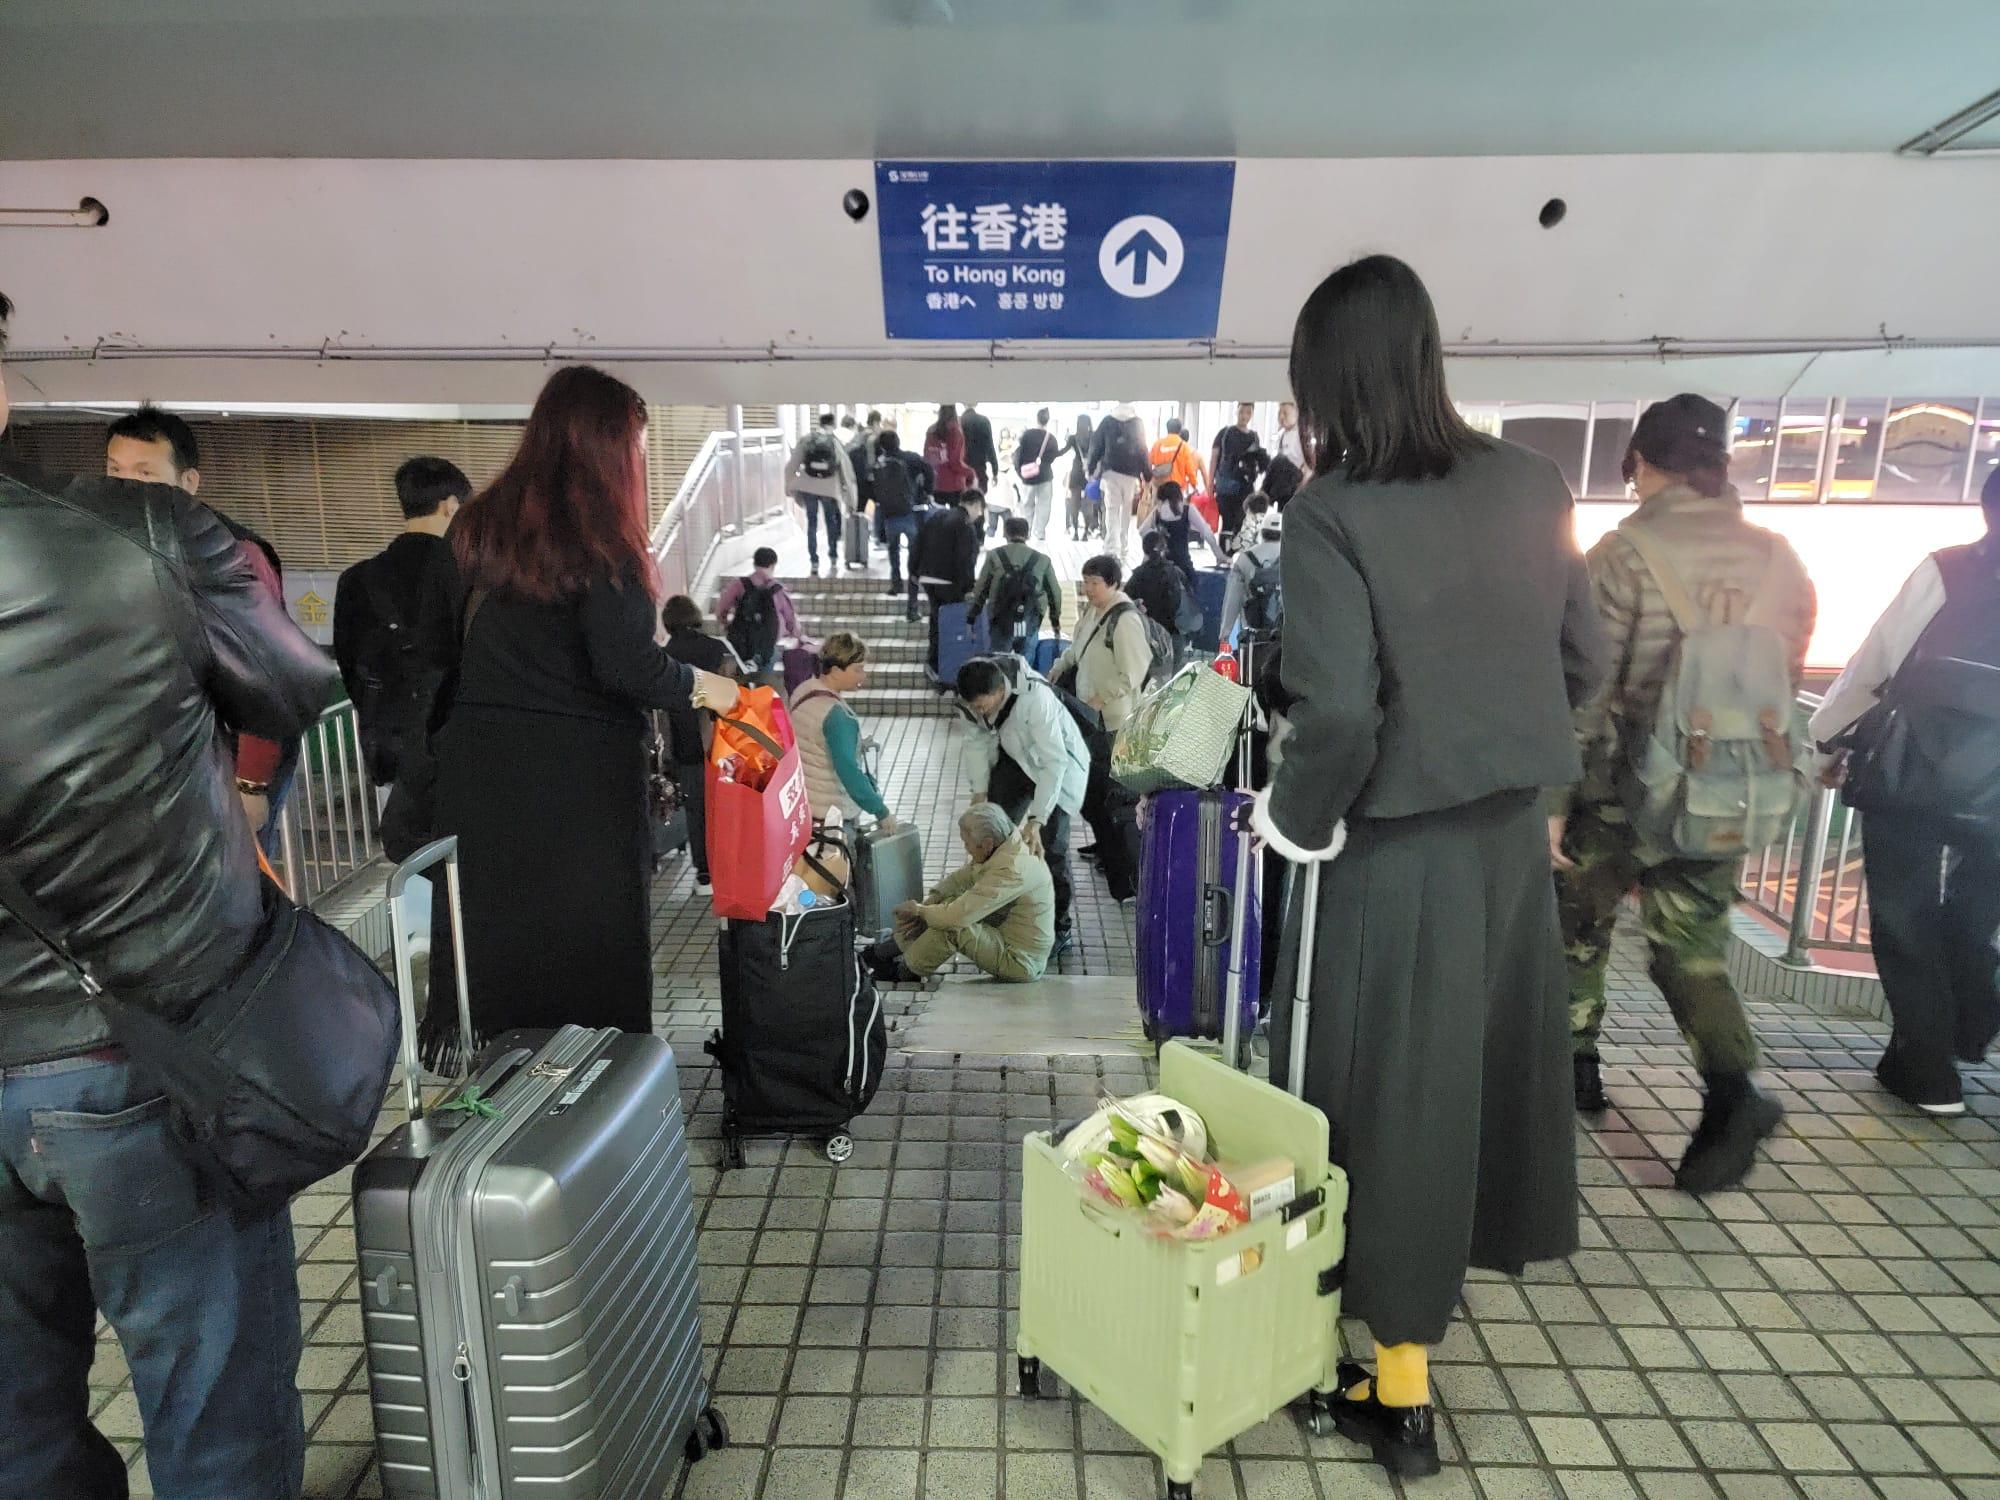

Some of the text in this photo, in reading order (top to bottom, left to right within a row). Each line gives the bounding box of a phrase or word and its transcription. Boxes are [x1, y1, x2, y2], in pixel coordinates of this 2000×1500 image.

[920, 203, 1068, 251] 往香港
[923, 265, 1066, 287] To Hong Kong
[926, 292, 977, 310] 香港へ
